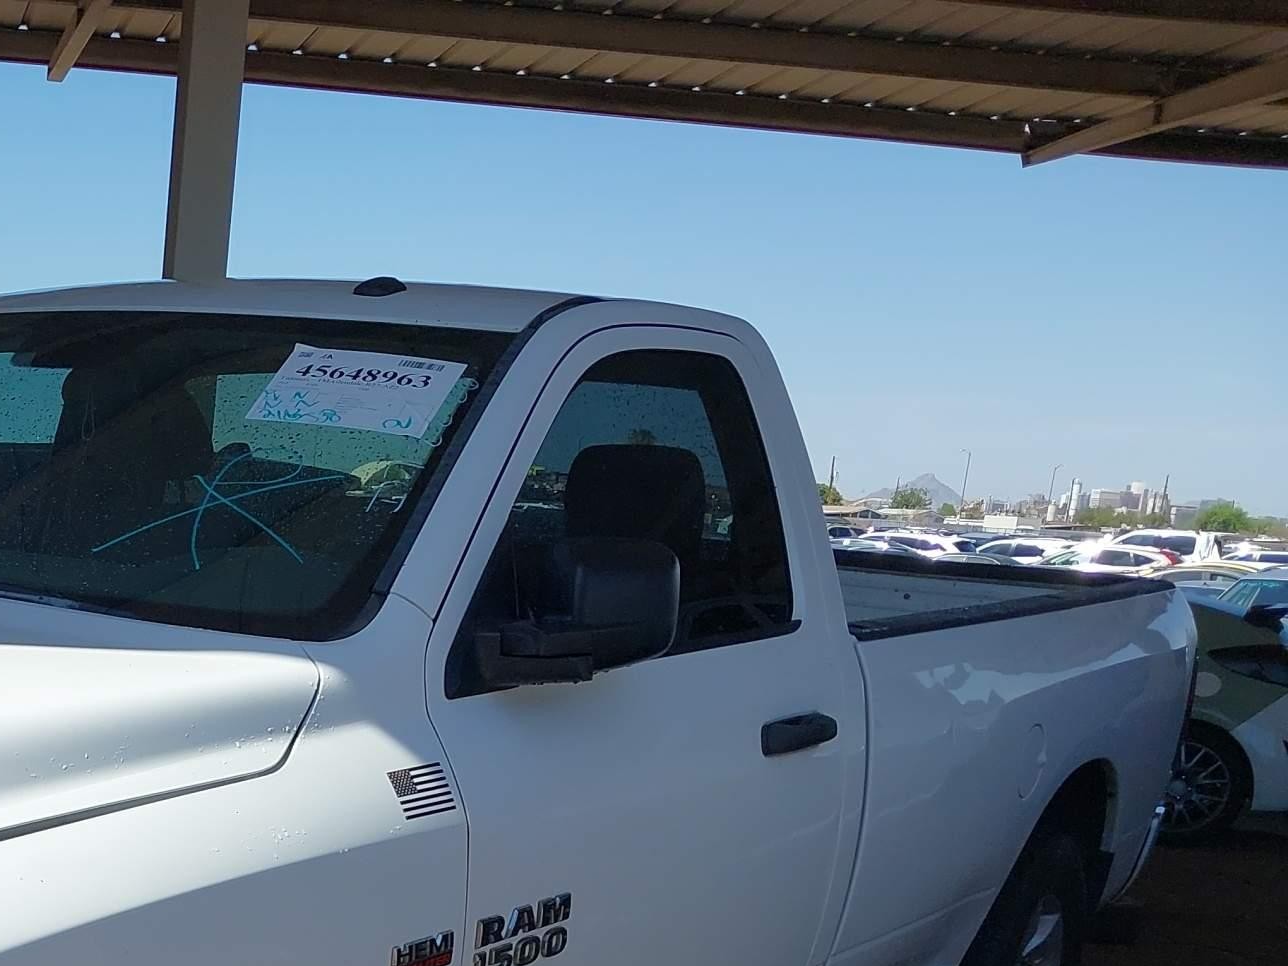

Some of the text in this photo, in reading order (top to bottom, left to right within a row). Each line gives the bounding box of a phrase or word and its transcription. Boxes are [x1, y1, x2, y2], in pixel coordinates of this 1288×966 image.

[295, 362, 432, 390] 45648963
[474, 892, 572, 949] RAM
[391, 929, 455, 966] HEMI
